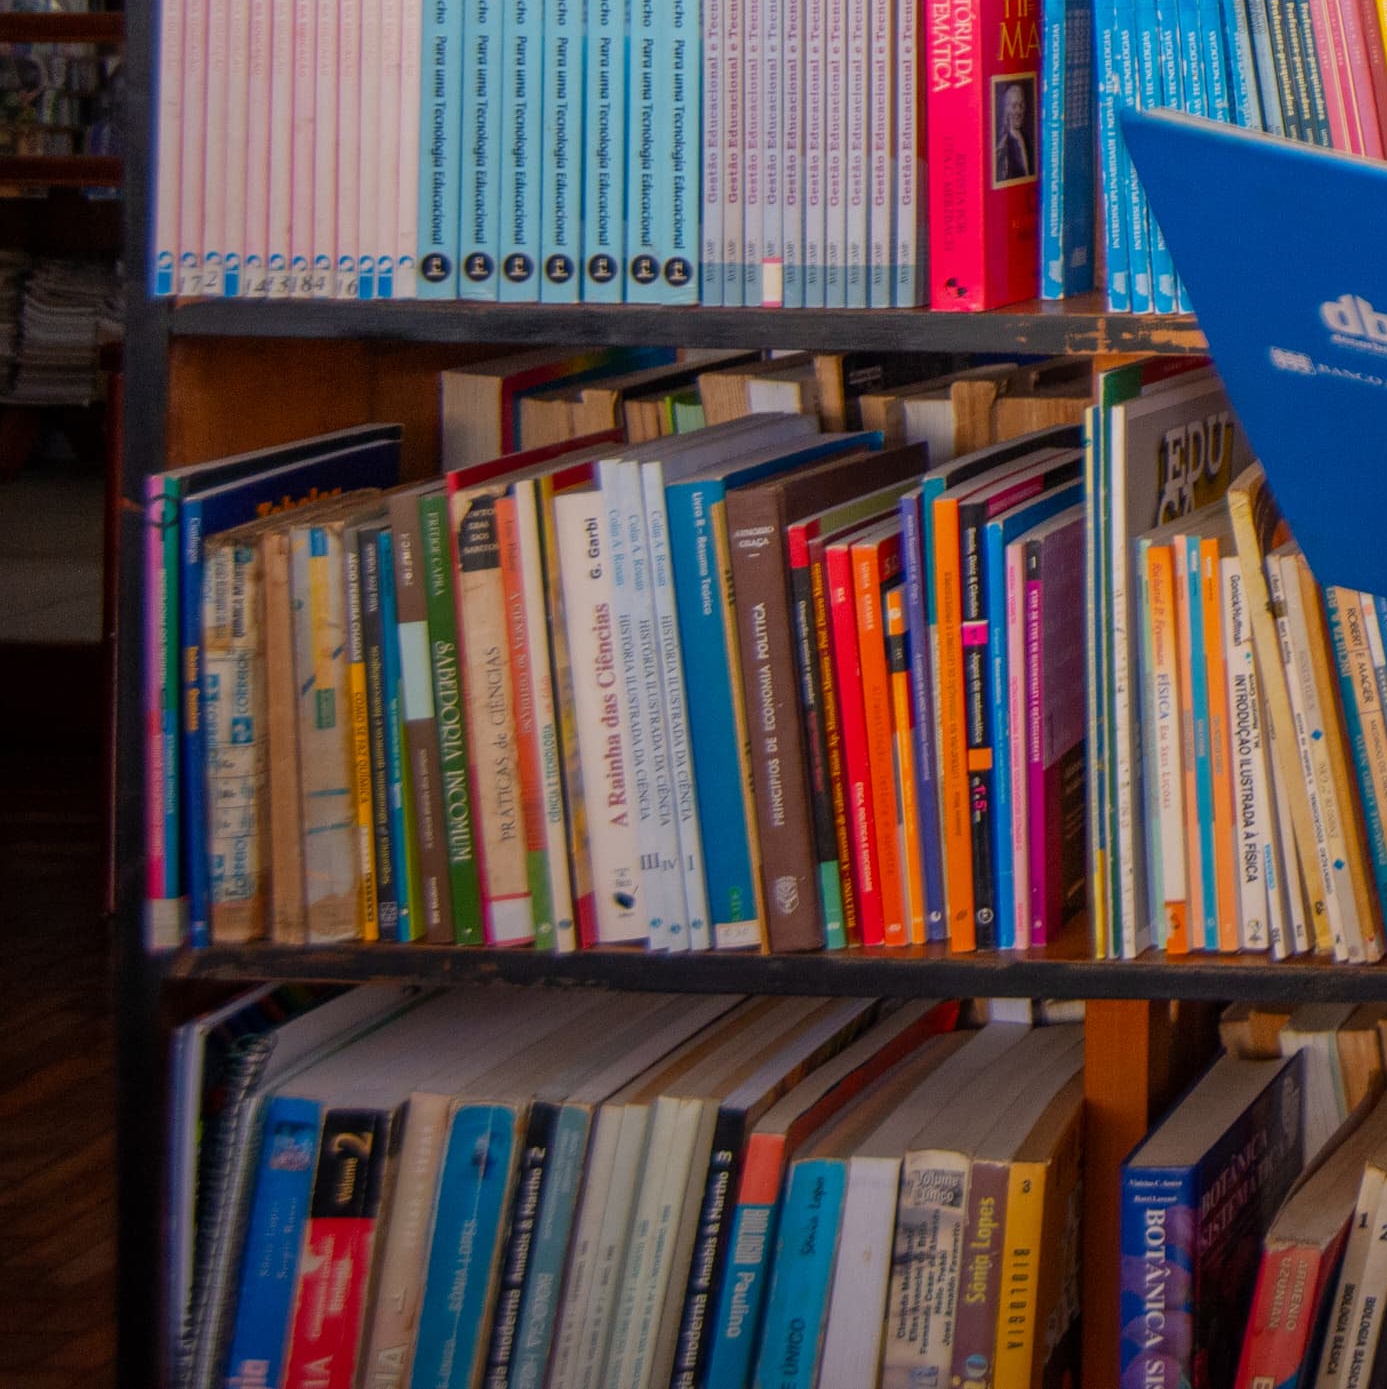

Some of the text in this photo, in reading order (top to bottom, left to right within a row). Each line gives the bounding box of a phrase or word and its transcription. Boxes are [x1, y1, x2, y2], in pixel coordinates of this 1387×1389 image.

[672, 39, 684, 69] Para
[673, 73, 682, 101] uma
[953, 58, 971, 88] DA
[727, 56, 739, 147] Educacional
[670, 105, 685, 171] Tecnologia
[672, 175, 685, 249] Educacional
[727, 152, 739, 203] Gestão
[1317, 362, 1382, 386] BANCO
[585, 516, 602, 579] G. Garbi
[660, 614, 680, 675] HISTÓRIA
[590, 602, 629, 827] A Rainha das Ciências
[666, 677, 686, 747] ILUSTRADA
[750, 602, 785, 825] PRINCÍPIOS DE ECONOMIA POLÍTICA
[433, 640, 473, 861] SABEDORIA INCOMUM
[1232, 674, 1260, 882] INTRODUÇÃO ILUSTRADA À FÍSICA
[676, 770, 694, 821] CIÊNCIA
[965, 1195, 1001, 1304] Sônia Lopes
[1145, 1209, 1170, 1346] BOTÂNICA
[683, 1293, 707, 1367] moderna
[697, 1236, 717, 1286] Amabis
[724, 1270, 754, 1339] Paulino
